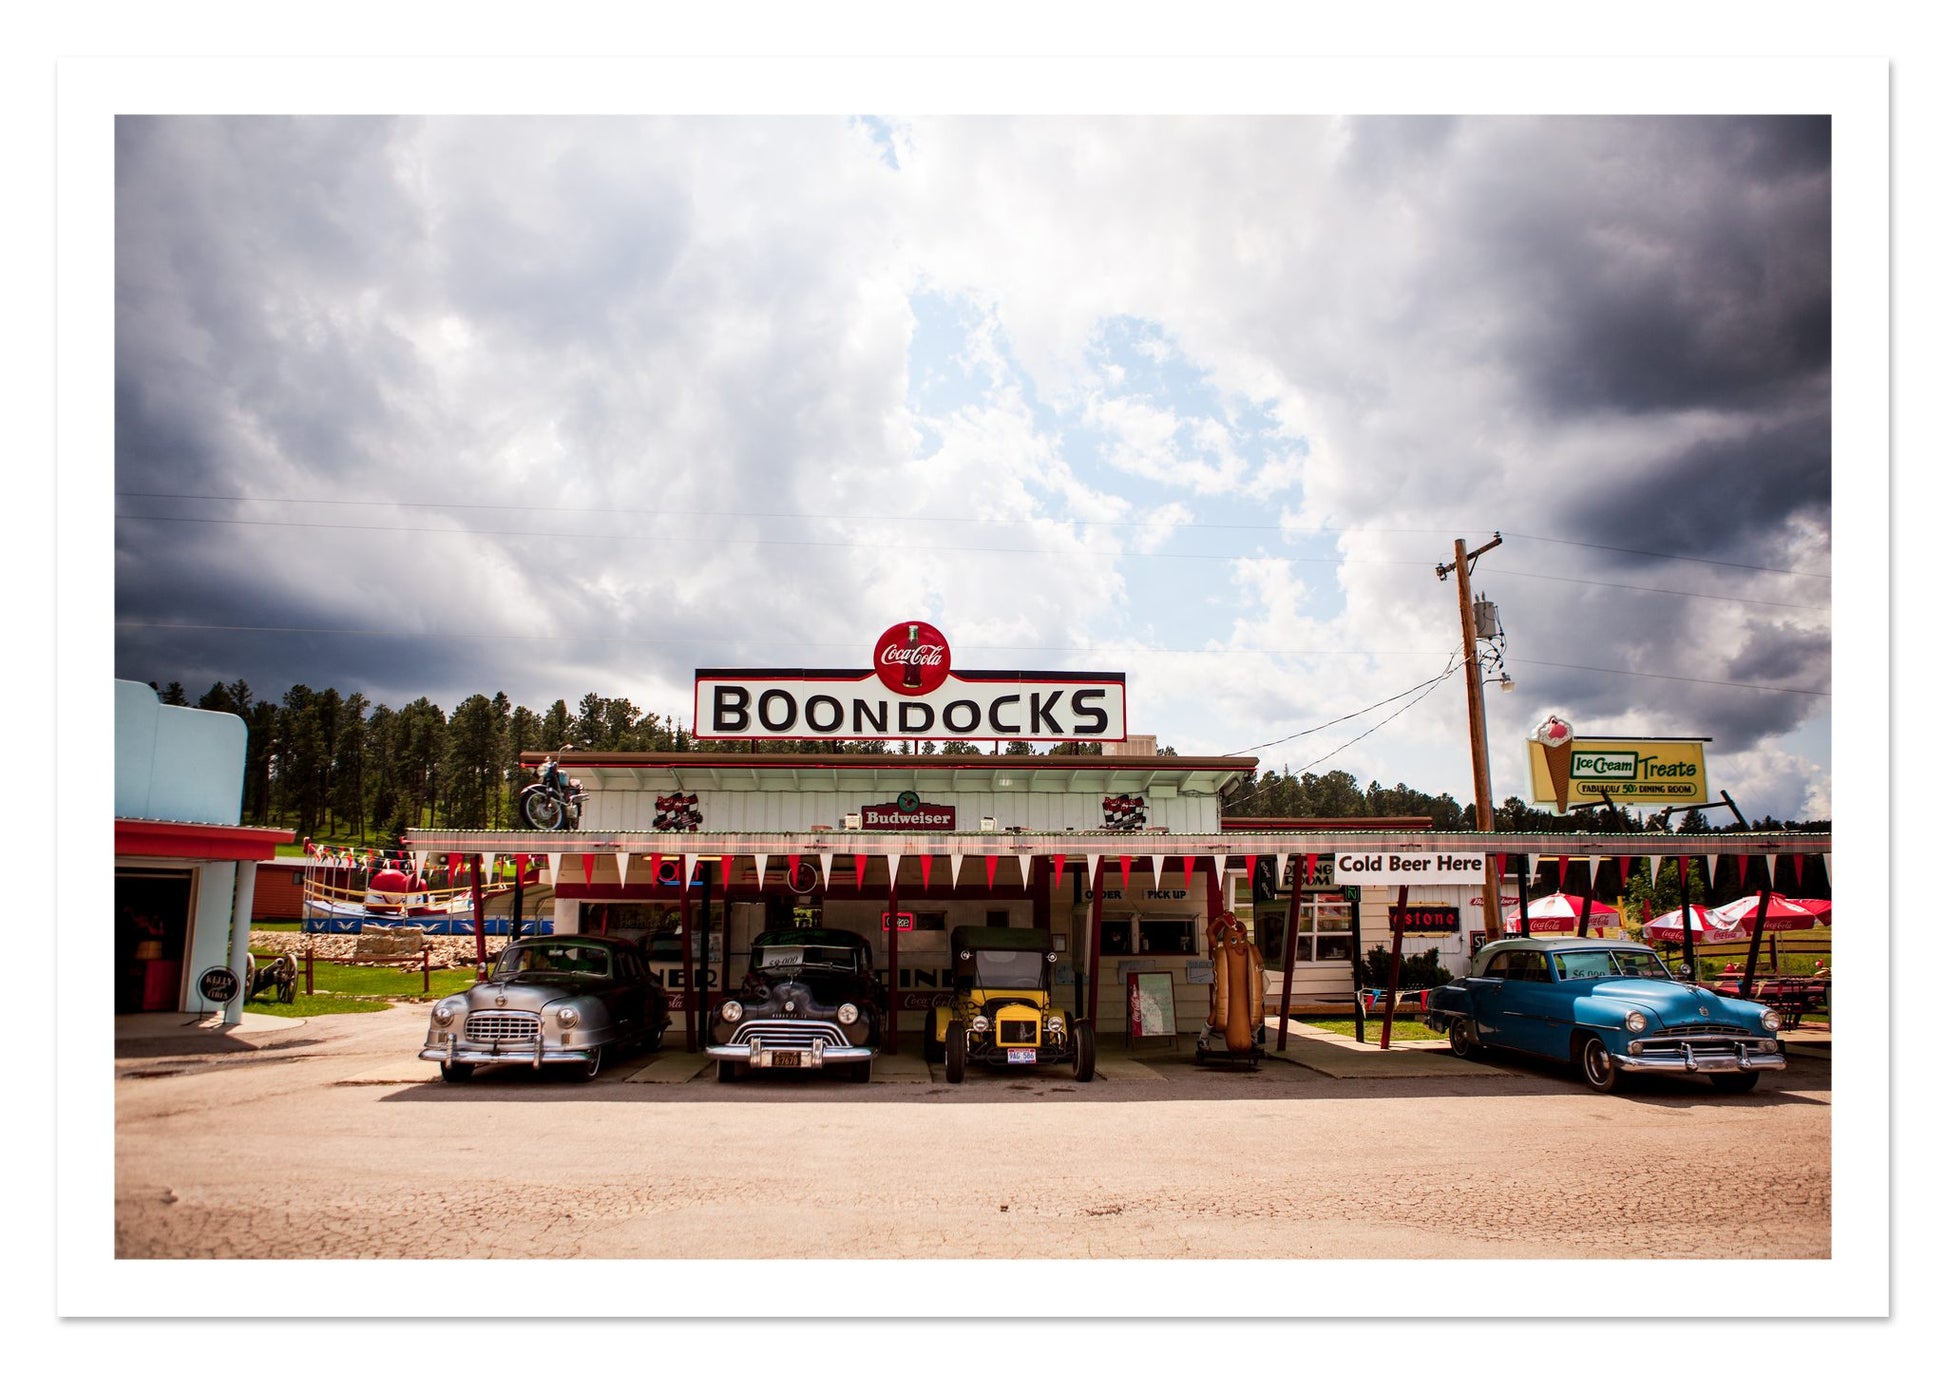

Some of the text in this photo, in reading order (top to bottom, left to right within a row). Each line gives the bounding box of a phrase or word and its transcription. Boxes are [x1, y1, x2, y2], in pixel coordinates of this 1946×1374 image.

[880, 643, 945, 667] Coca-Cola
[713, 685, 1108, 734] BOONDOCKS
[1576, 755, 1697, 779] Ice Cream Treats
[1582, 784, 1620, 793] FABULOUS
[1639, 785, 1665, 793] DINING
[1668, 785, 1691, 793] ROOM
[866, 812, 951, 824] Budweiser
[1339, 855, 1482, 872] Cold Beer Here
[1085, 890, 1122, 899] ODER
[1147, 890, 1186, 899] PICK UP
[1530, 919, 1560, 930] Coca-Cola
